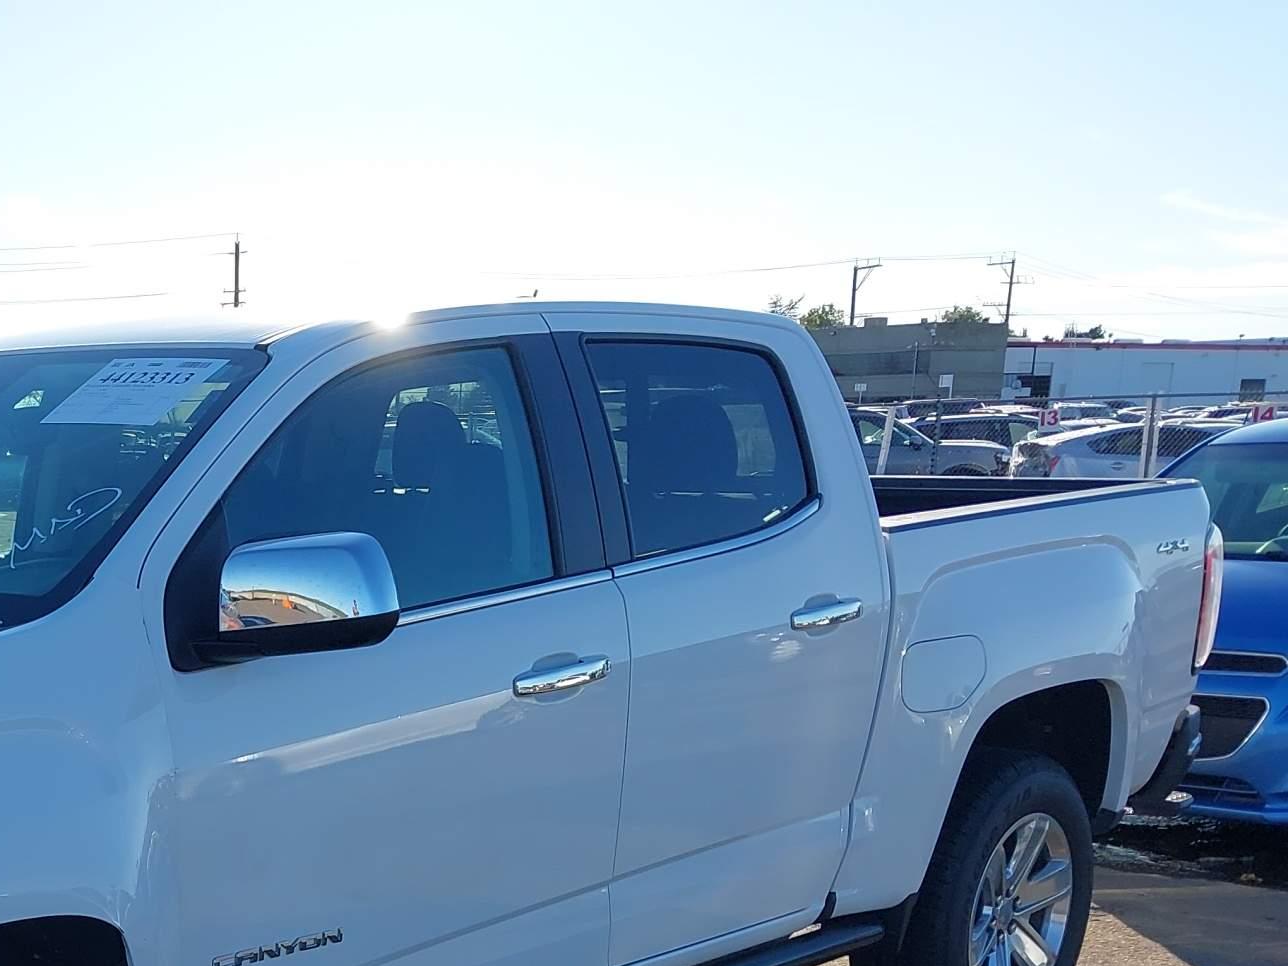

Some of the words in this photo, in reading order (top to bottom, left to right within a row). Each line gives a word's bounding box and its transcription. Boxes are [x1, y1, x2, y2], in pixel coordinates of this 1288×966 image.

[98, 371, 196, 385] 44123313
[1040, 410, 1059, 426] 13
[1253, 406, 1274, 422] 14
